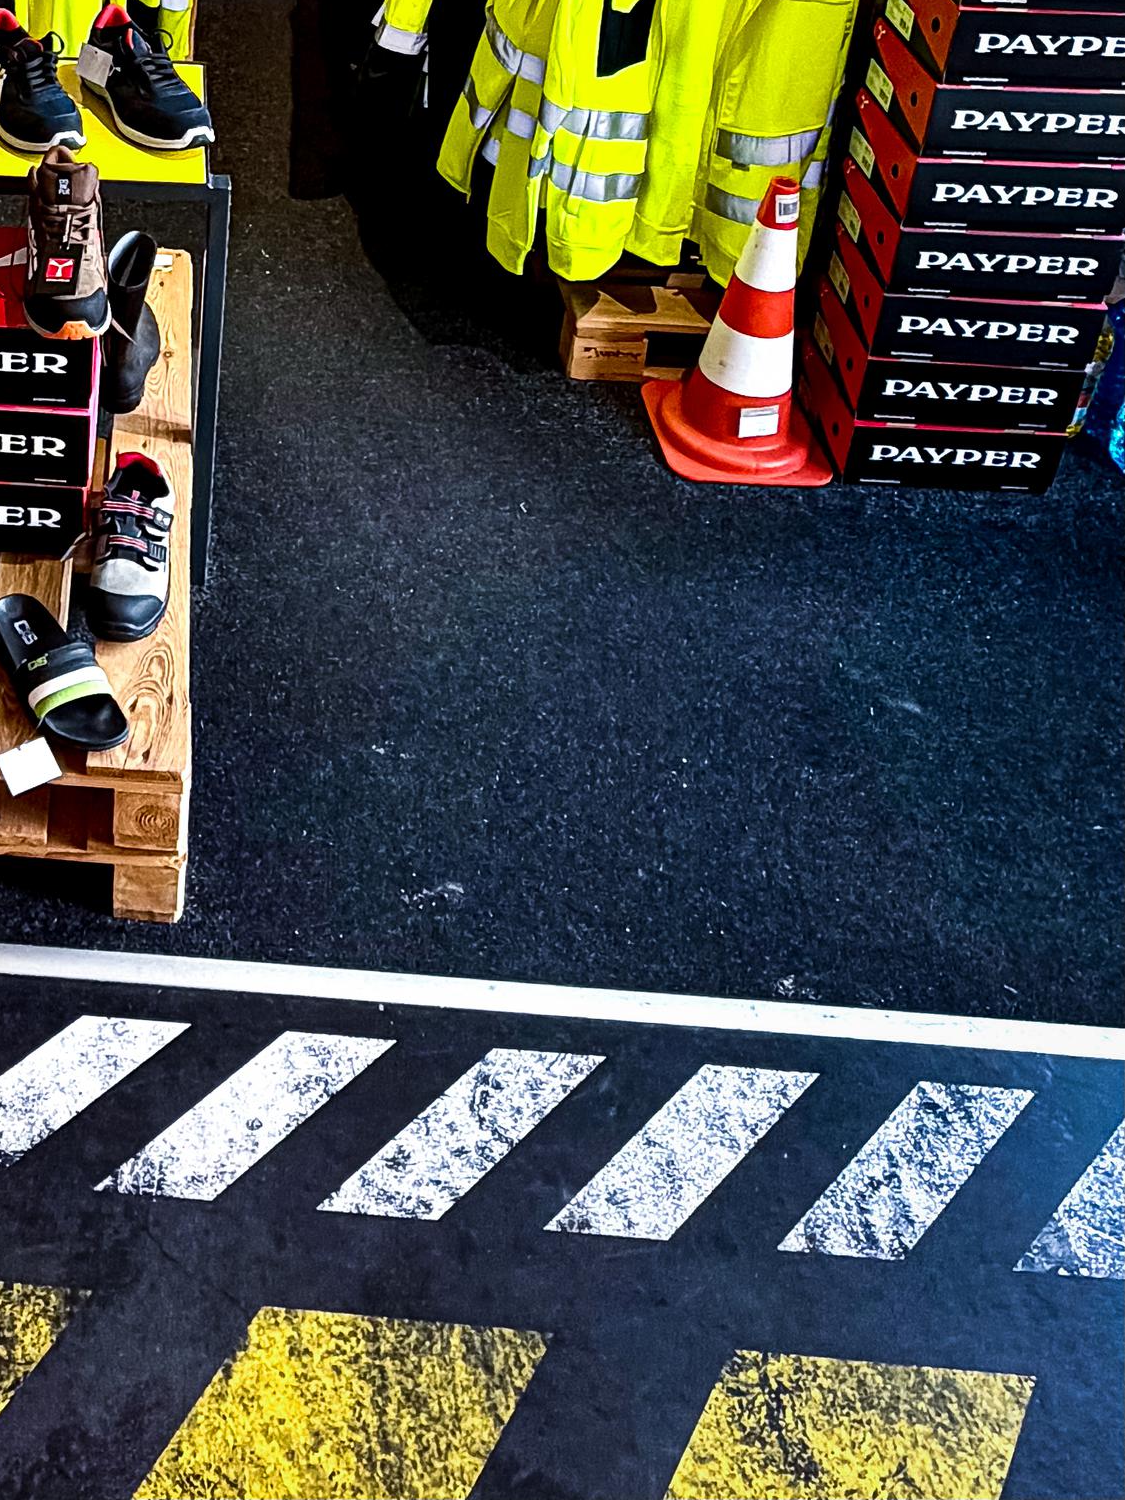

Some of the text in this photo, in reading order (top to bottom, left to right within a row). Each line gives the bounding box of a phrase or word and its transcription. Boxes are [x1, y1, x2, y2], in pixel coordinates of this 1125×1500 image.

[932, 183, 1118, 208] PAYPER
[916, 251, 1099, 276] PAYPER
[897, 316, 1079, 344] PAYPER
[882, 379, 1058, 405] PAYPER
[868, 444, 1041, 469] PAYPER
